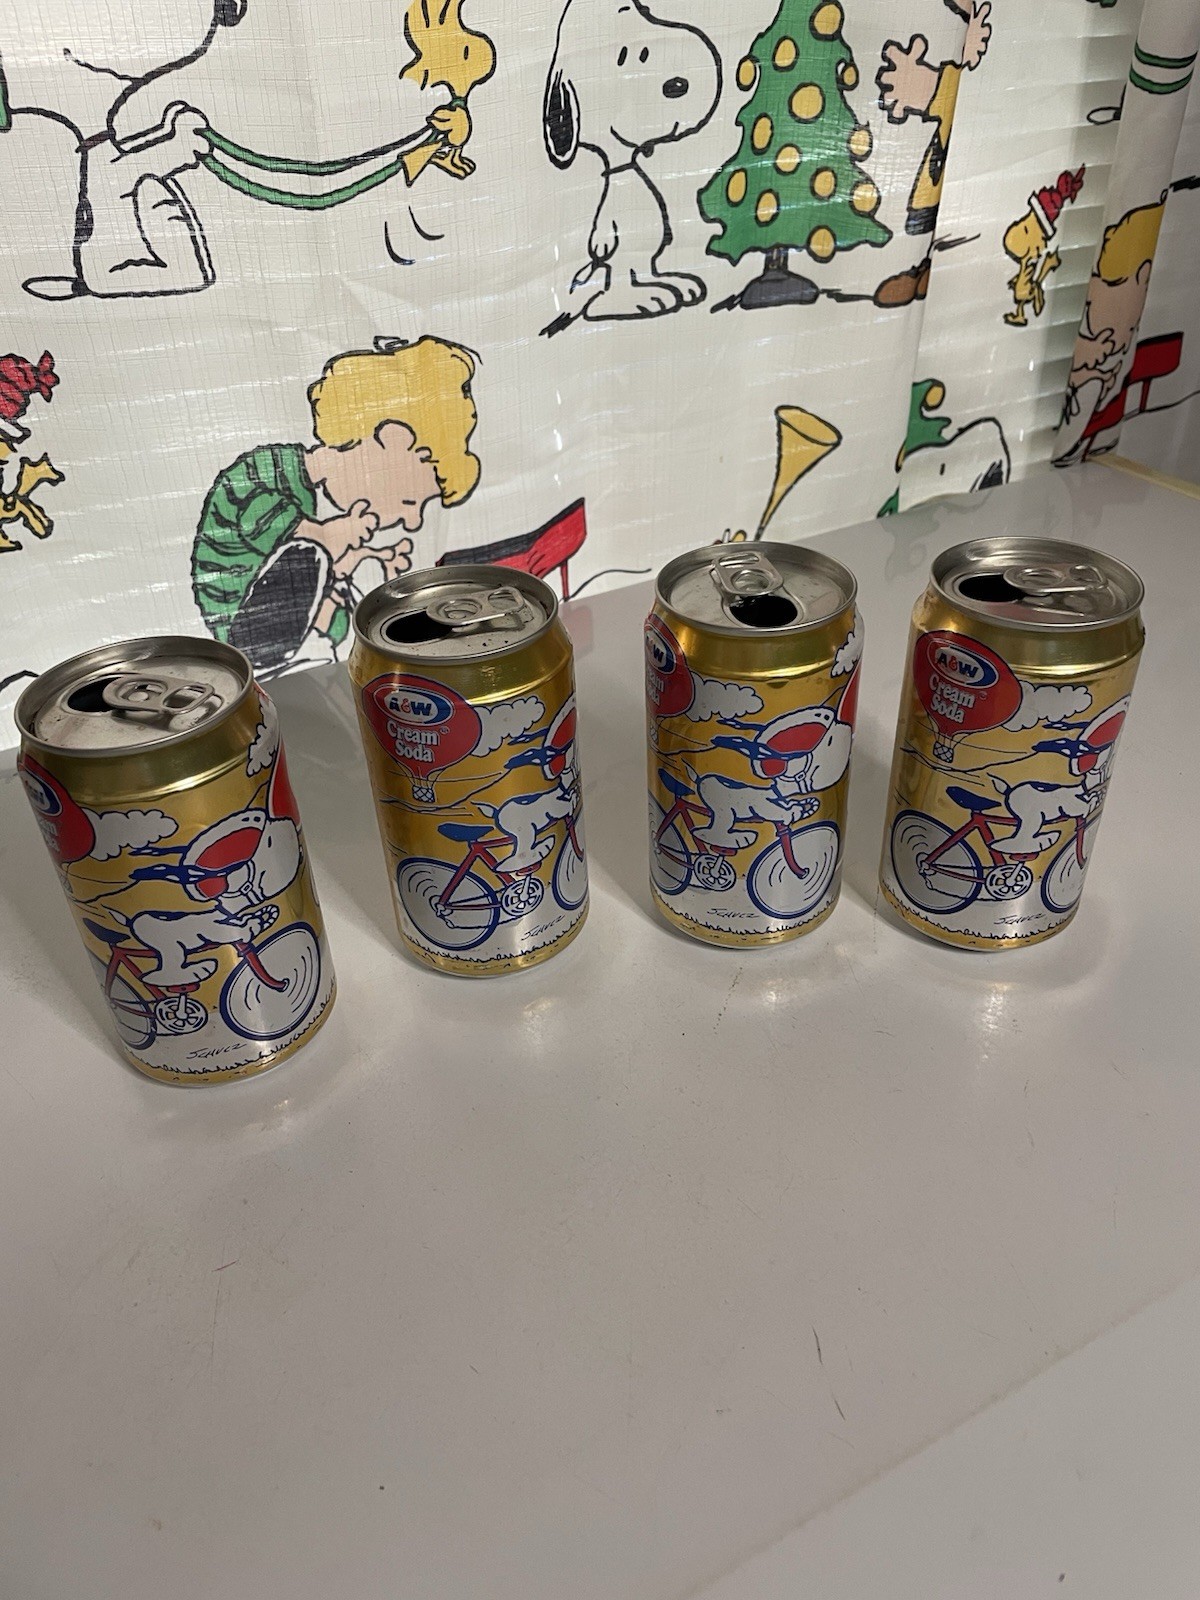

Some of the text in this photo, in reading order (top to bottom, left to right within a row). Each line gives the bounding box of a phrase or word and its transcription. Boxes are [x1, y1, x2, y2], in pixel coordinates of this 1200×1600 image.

[937, 652, 979, 678] A&W
[930, 674, 976, 708] Cream
[389, 697, 432, 717] A&W
[930, 694, 965, 723] Soda
[386, 720, 441, 746] Cream
[395, 739, 435, 763] Soda
